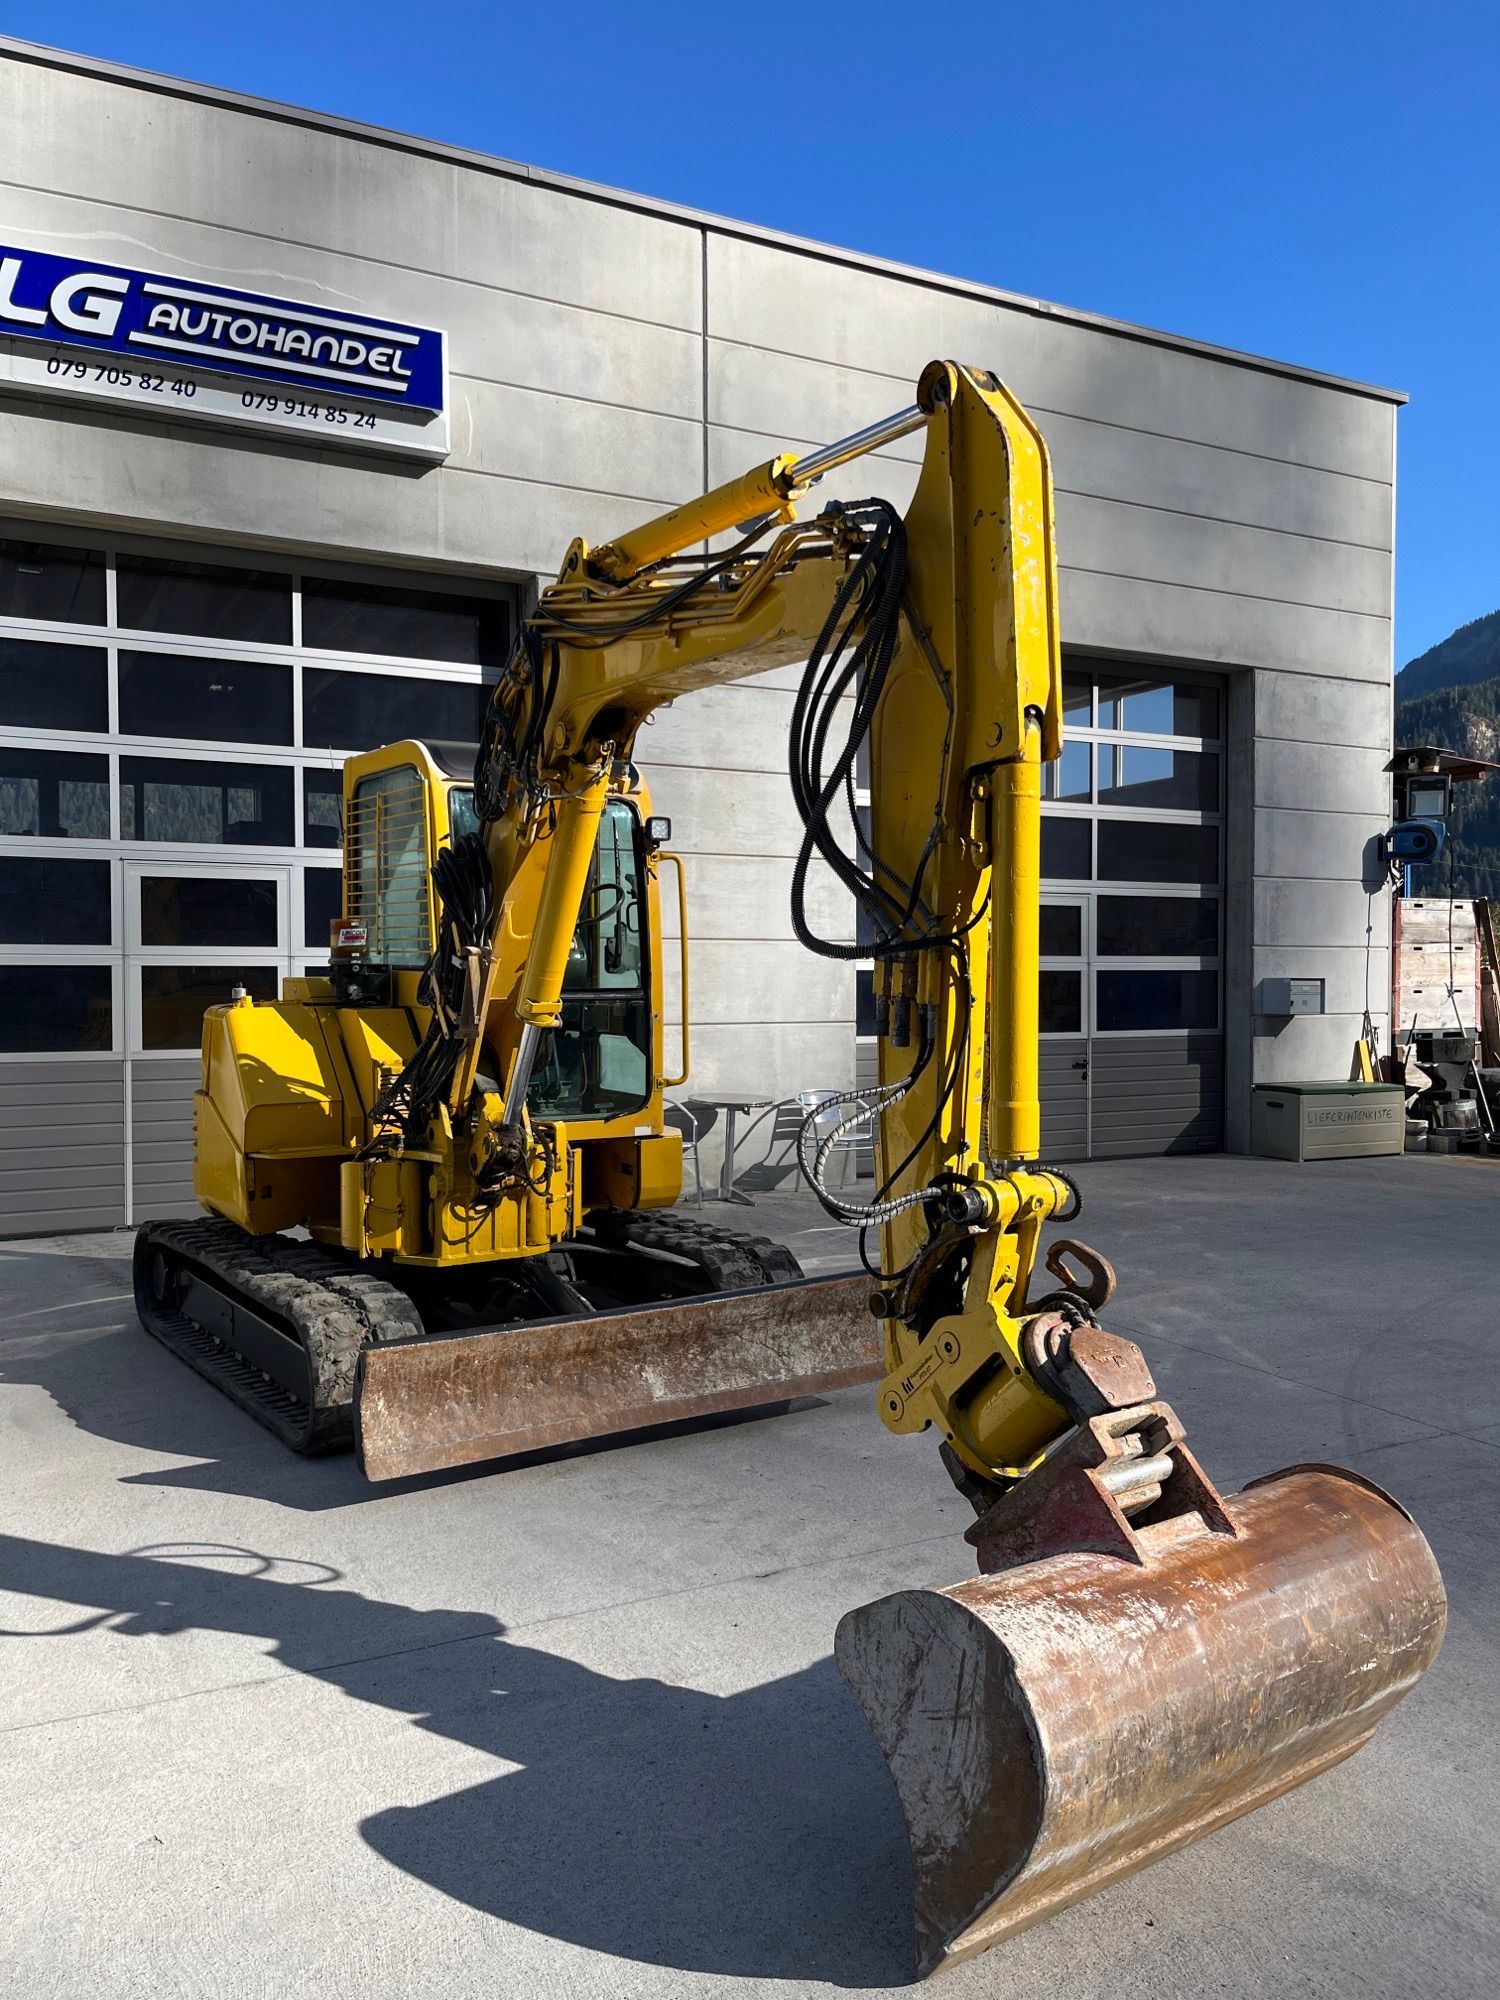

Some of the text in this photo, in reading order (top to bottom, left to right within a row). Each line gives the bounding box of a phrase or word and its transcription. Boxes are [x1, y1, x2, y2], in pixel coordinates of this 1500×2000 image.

[148, 303, 412, 376] AUTOHANDEL
[47, 357, 197, 397] 079 705 82 40
[241, 391, 376, 429] 079 914 85 24
[1307, 1108, 1393, 1124] LIEFERANTENKISTE
